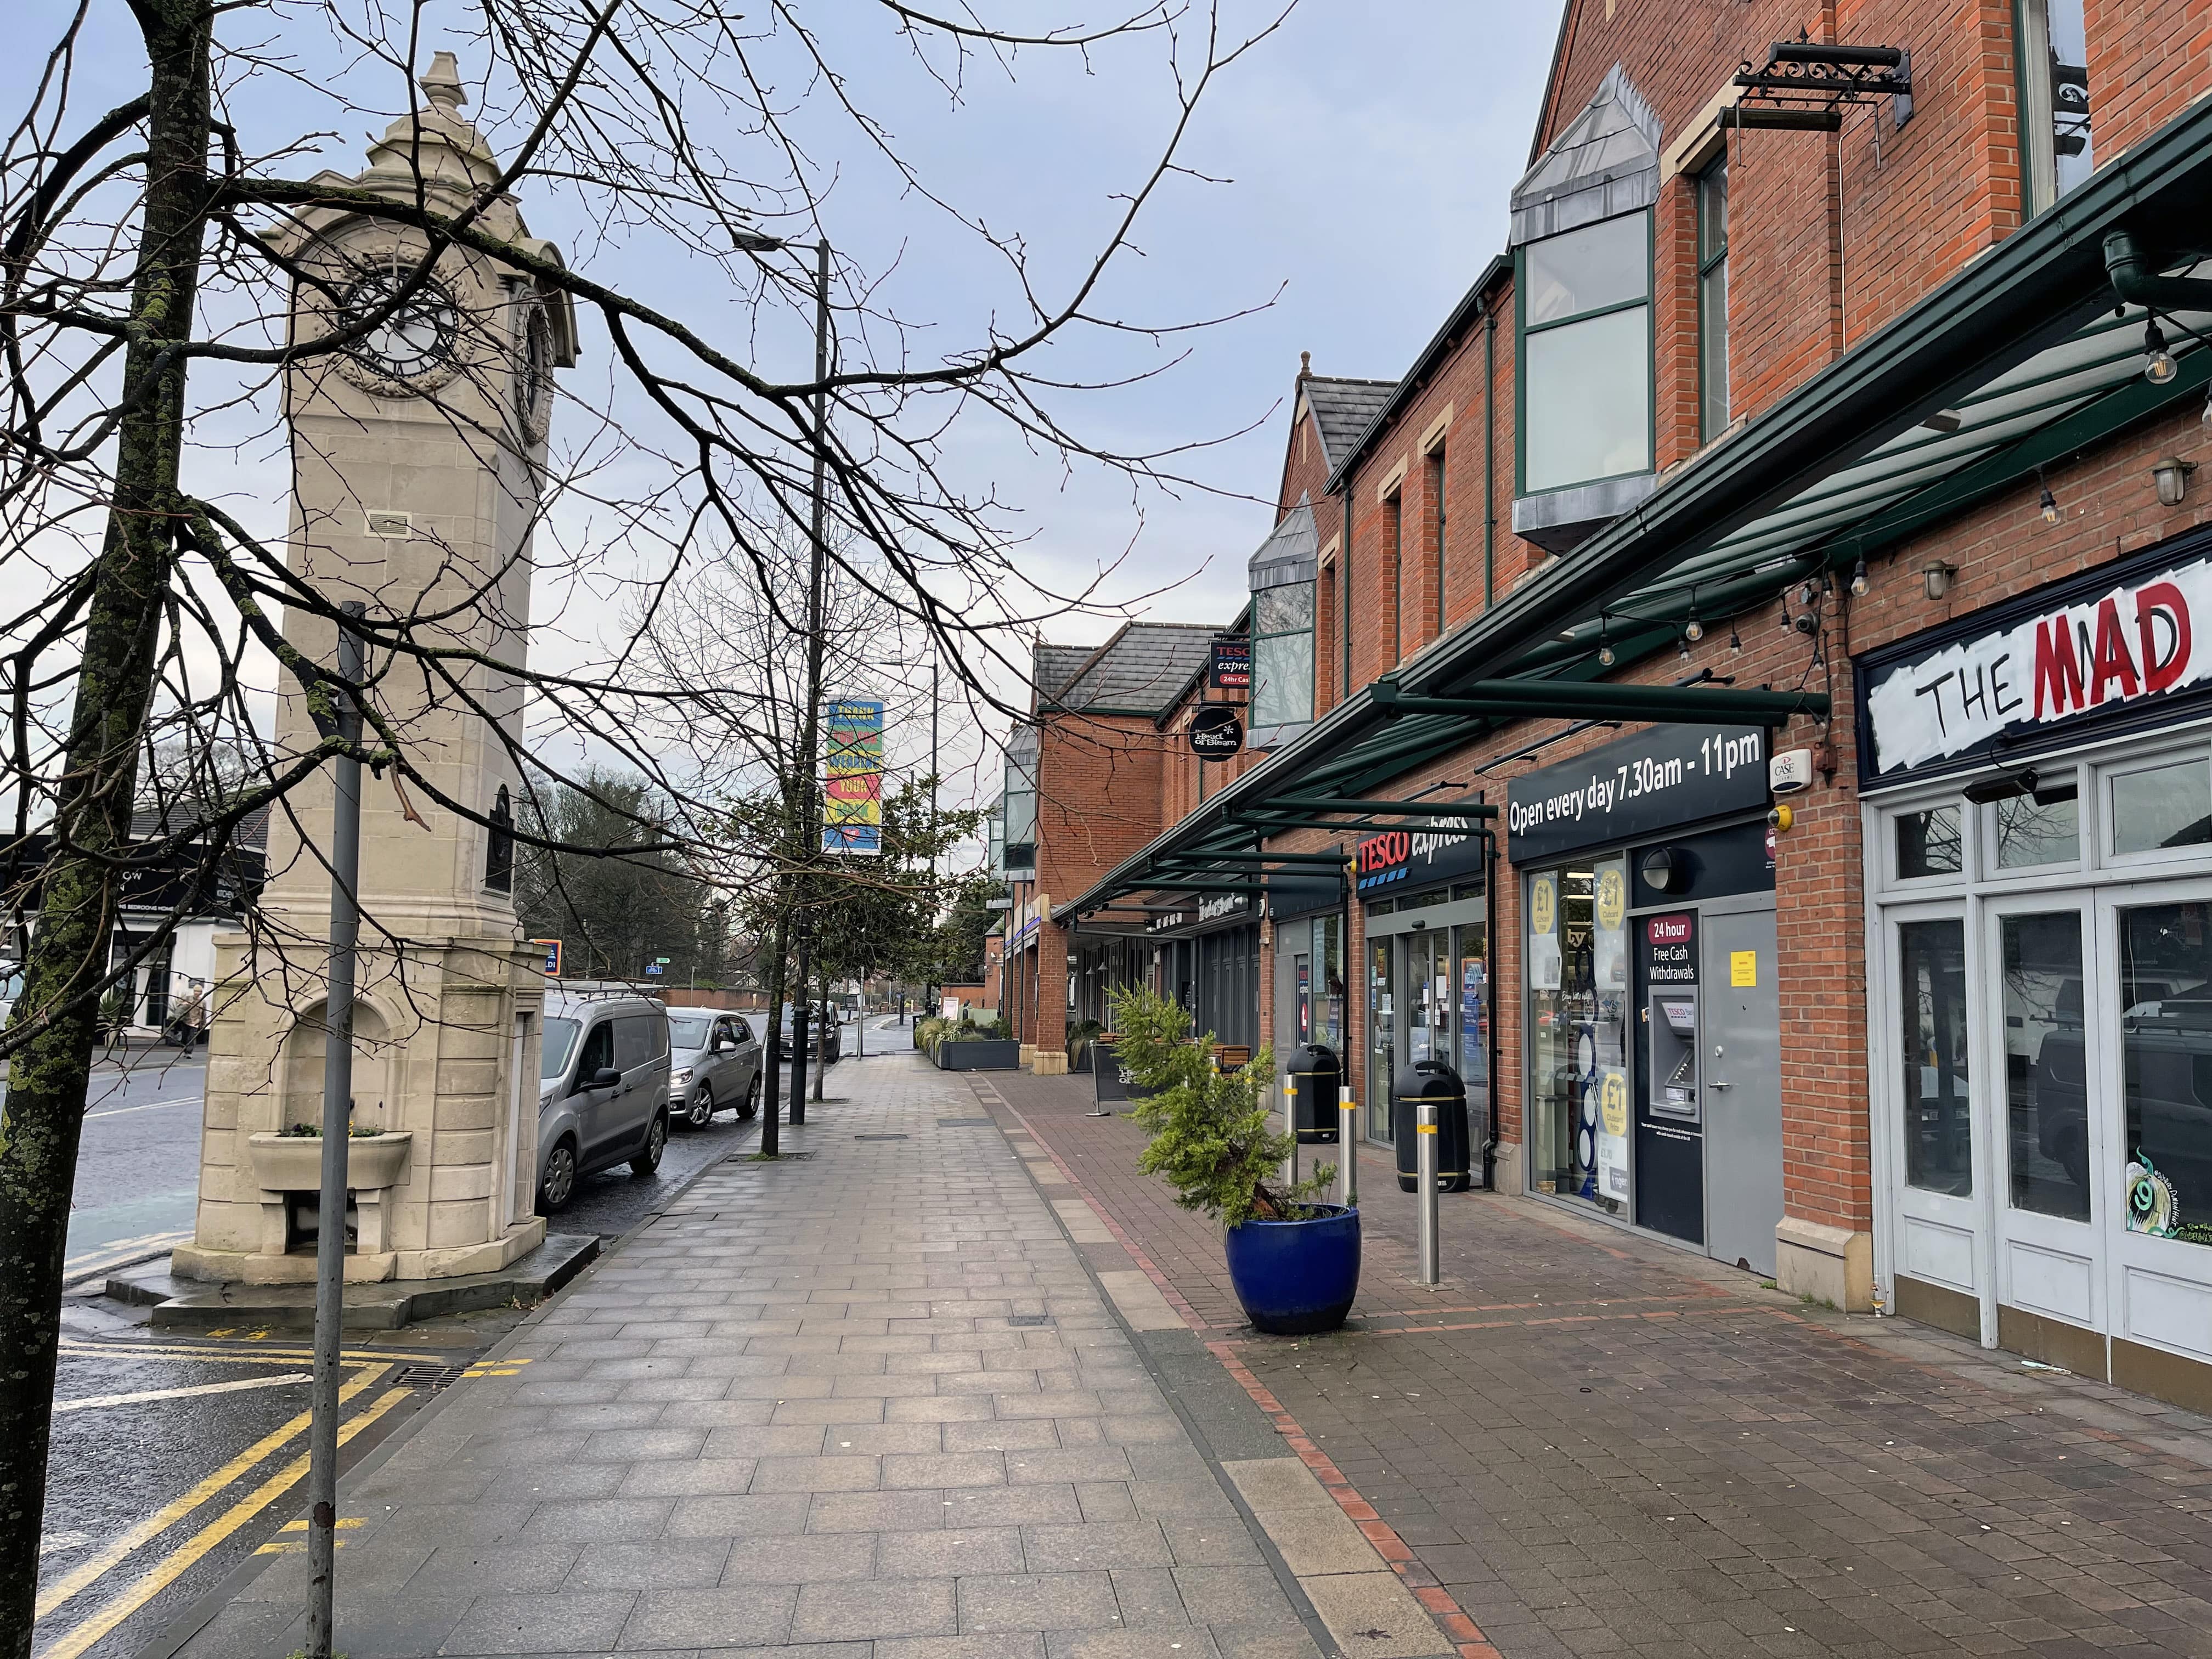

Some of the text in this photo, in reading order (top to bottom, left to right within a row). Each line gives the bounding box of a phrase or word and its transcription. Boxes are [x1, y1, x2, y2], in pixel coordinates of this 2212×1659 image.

[1216, 646, 1250, 657] TESC
[1217, 661, 1250, 673] expre
[1915, 582, 2192, 738] THE MAD
[838, 705, 874, 720] THANK
[833, 730, 854, 743] YOU
[1775, 763, 1795, 776] CASE
[839, 779, 867, 793] YOUR
[1510, 801, 1543, 837] Open
[1546, 789, 1585, 821] every
[1587, 775, 1616, 814] day
[1617, 757, 1682, 801] 7.30am
[1701, 732, 1760, 780] 11pm
[1358, 832, 1409, 873] TESCO
[1654, 921, 1685, 938] 24 hour
[1654, 945, 1688, 961] Free Cash
[1650, 964, 1694, 980] Withdrawals
[1607, 1080, 1622, 1111] £1
[2135, 1181, 2153, 1211] 9
